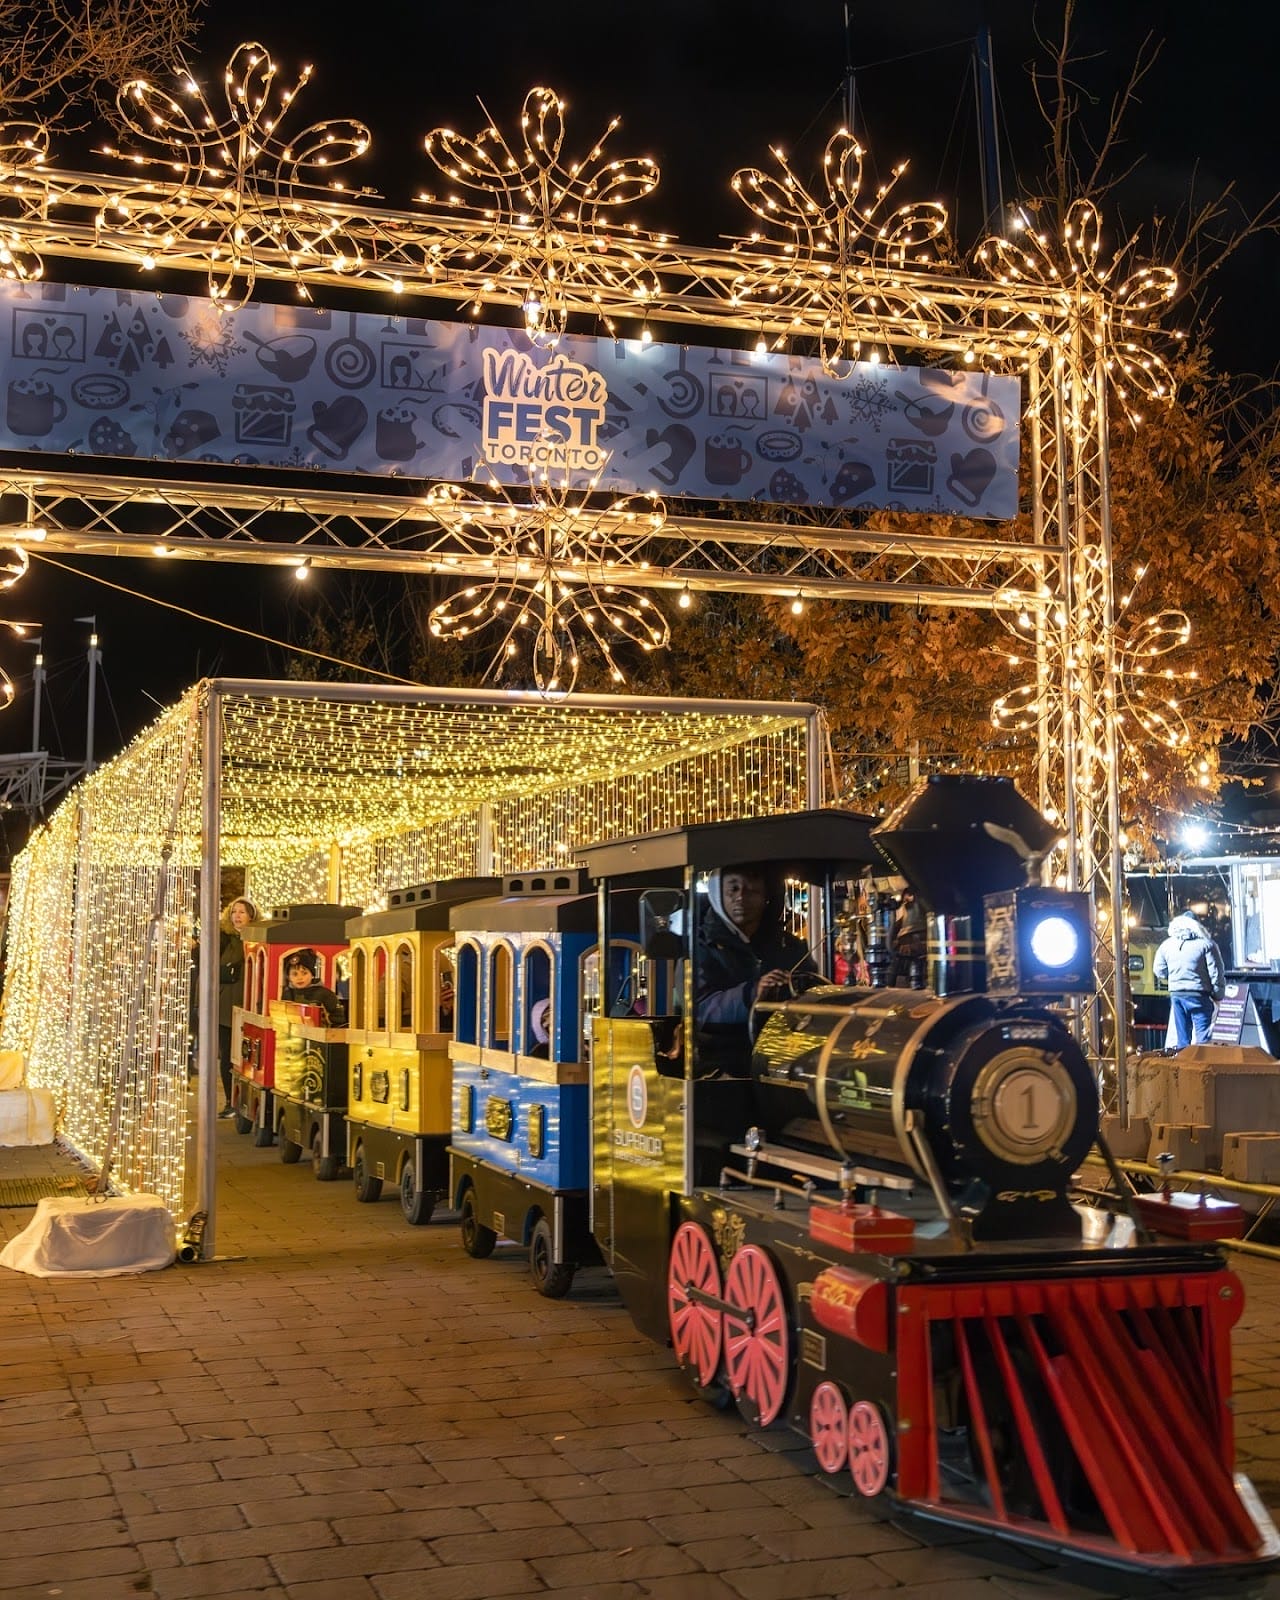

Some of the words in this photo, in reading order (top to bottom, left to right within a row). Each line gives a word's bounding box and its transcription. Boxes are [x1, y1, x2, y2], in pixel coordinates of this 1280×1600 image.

[488, 353, 603, 403] Winter
[487, 400, 600, 446] FEST
[487, 443, 599, 465] TORONTO
[1020, 1084, 1038, 1129] 1
